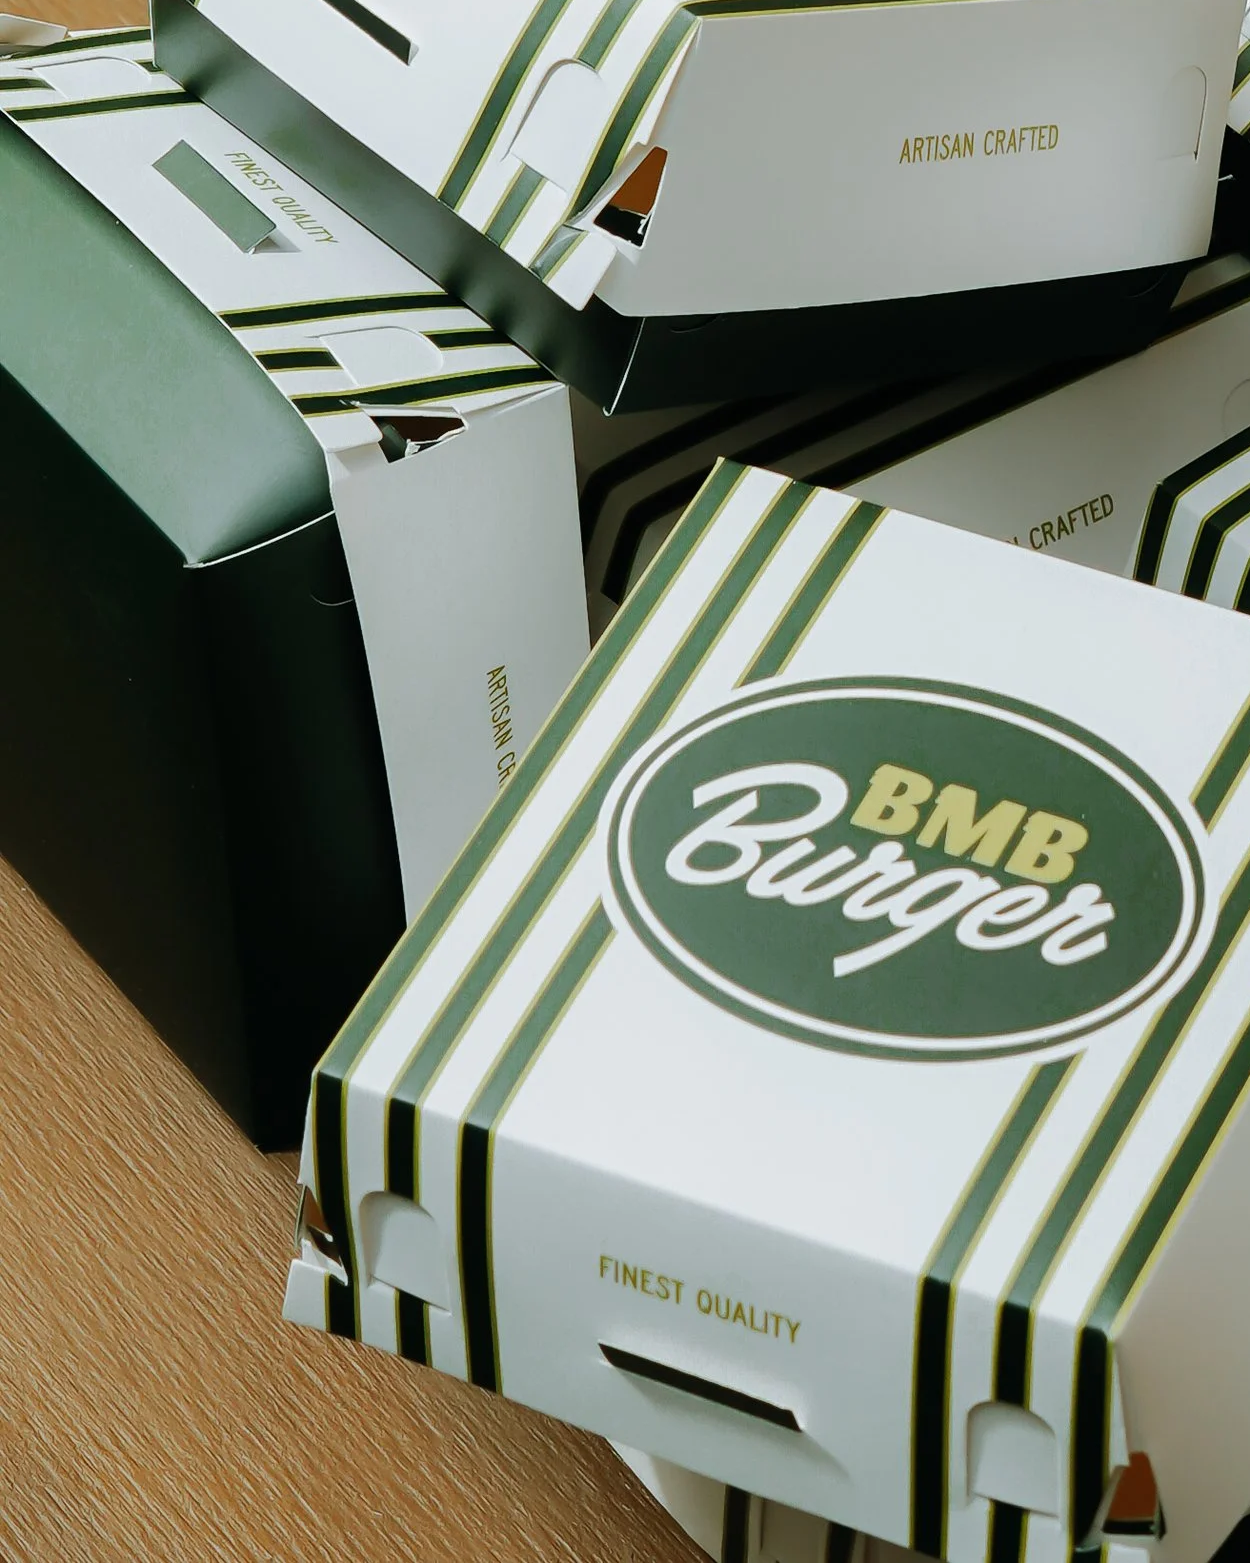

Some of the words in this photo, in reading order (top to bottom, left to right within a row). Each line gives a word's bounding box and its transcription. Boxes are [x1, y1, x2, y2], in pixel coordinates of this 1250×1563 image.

[899, 130, 975, 164] ARTISAN
[982, 124, 1060, 157] CRAFTED
[224, 149, 284, 194] FINEST
[274, 195, 339, 246] QUALITY
[1029, 493, 1114, 550] CRAFTED
[486, 664, 514, 750] ARTISAN
[497, 751, 517, 787] CR
[850, 763, 1089, 886] BMB
[665, 762, 1113, 978] Burger
[598, 1254, 685, 1306] FINEST
[697, 1290, 802, 1344] QUALITY
